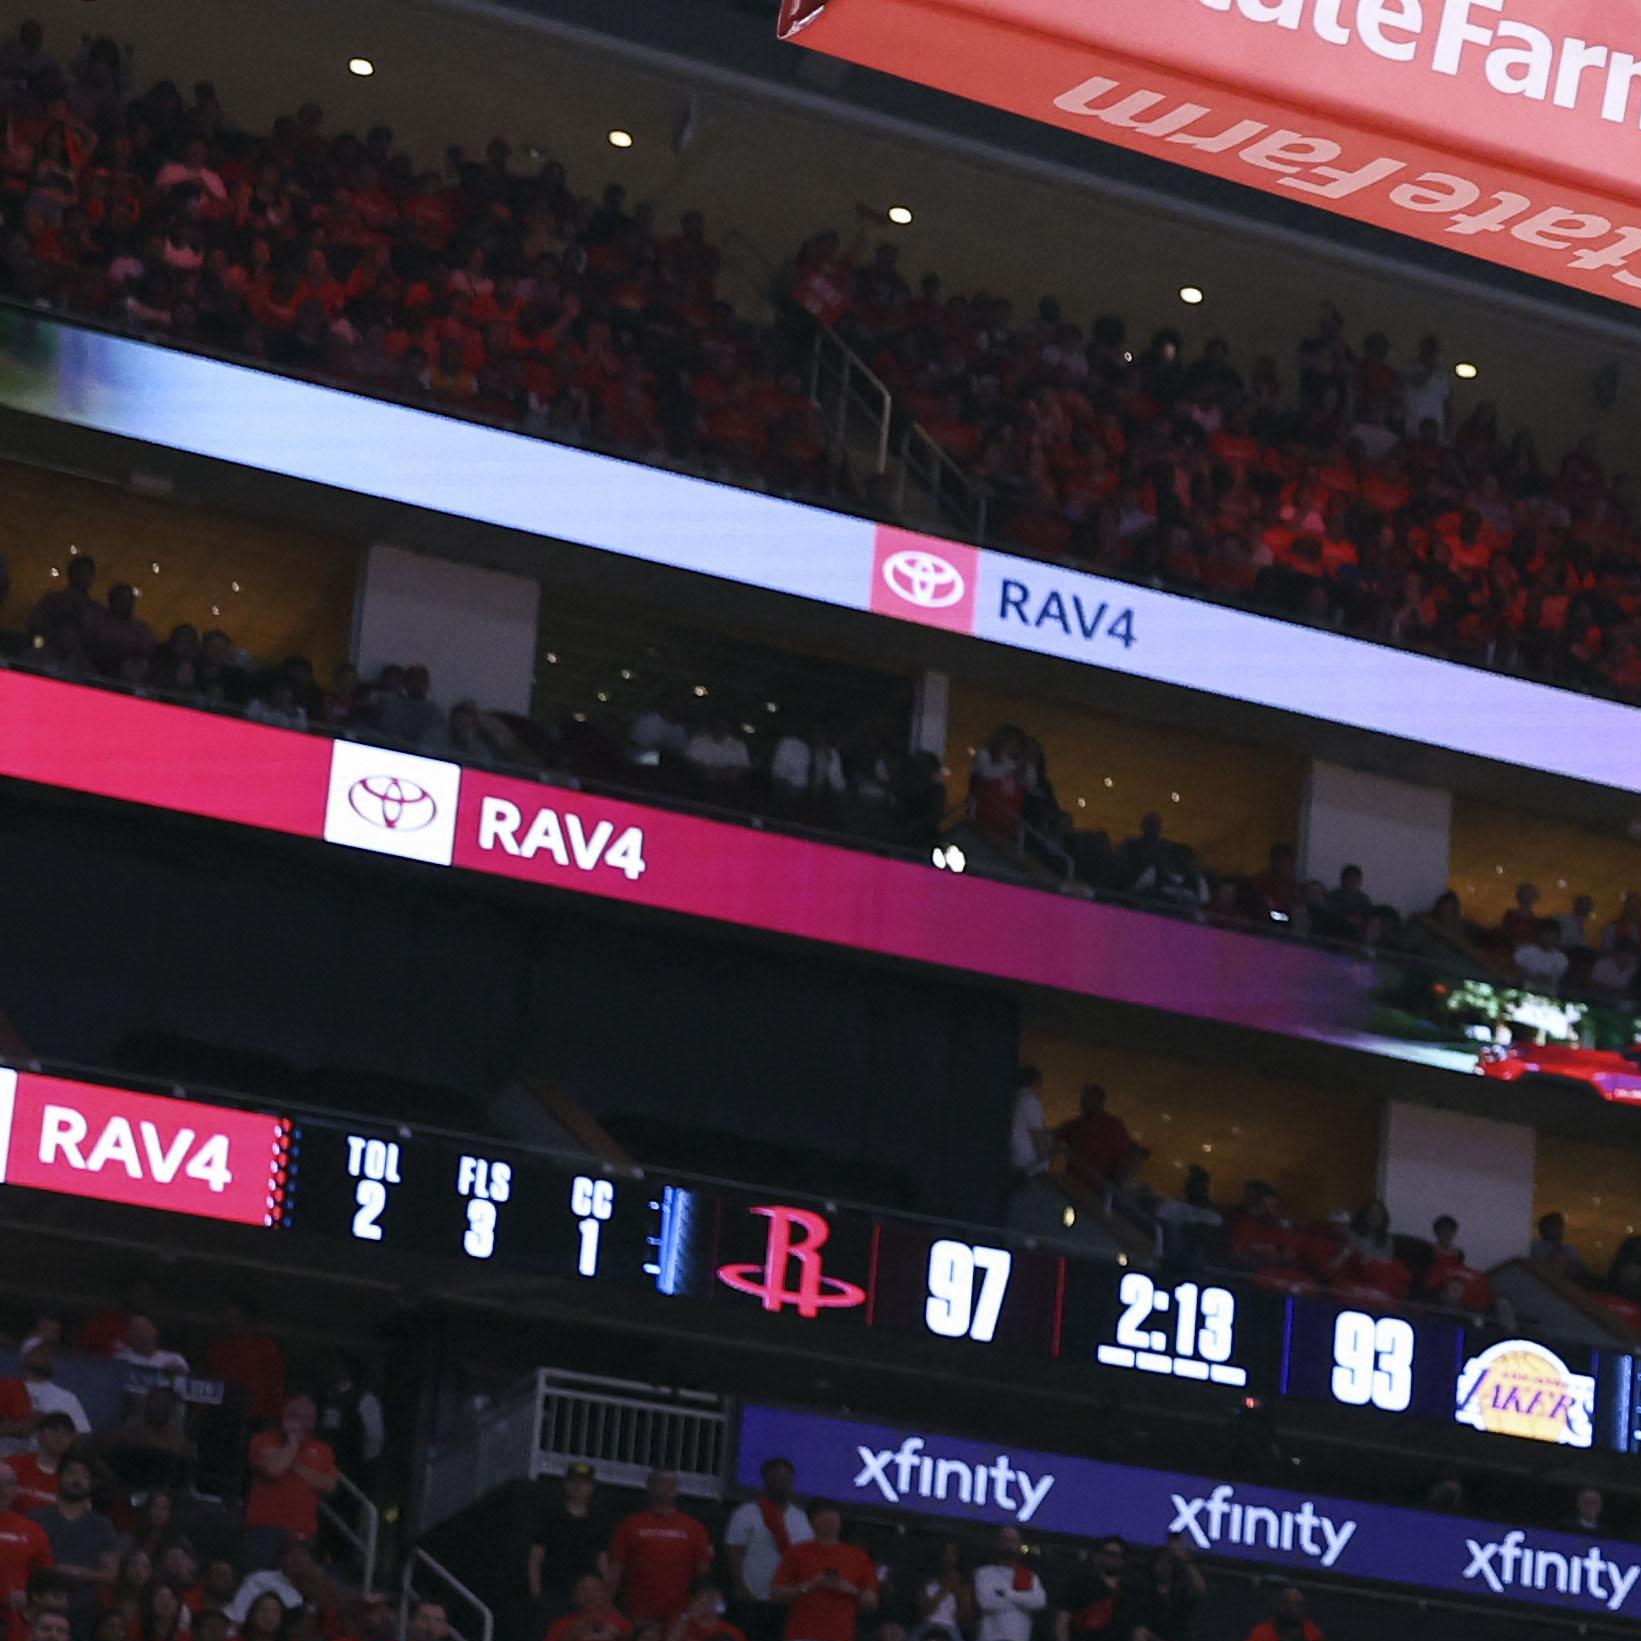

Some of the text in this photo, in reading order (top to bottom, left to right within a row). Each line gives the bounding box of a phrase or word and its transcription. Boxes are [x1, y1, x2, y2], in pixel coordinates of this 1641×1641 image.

[1001, 578, 1137, 650] RAV4
[476, 796, 647, 882] RAV4
[36, 1104, 233, 1193] RAV4
[347, 1135, 400, 1184] TOL
[457, 1155, 510, 1203] FLS
[352, 1179, 601, 1277] 2 3 1
[925, 1239, 1415, 1413] 97 2:13 93
[854, 1433, 1641, 1611] xfinity xfinity xfinity
